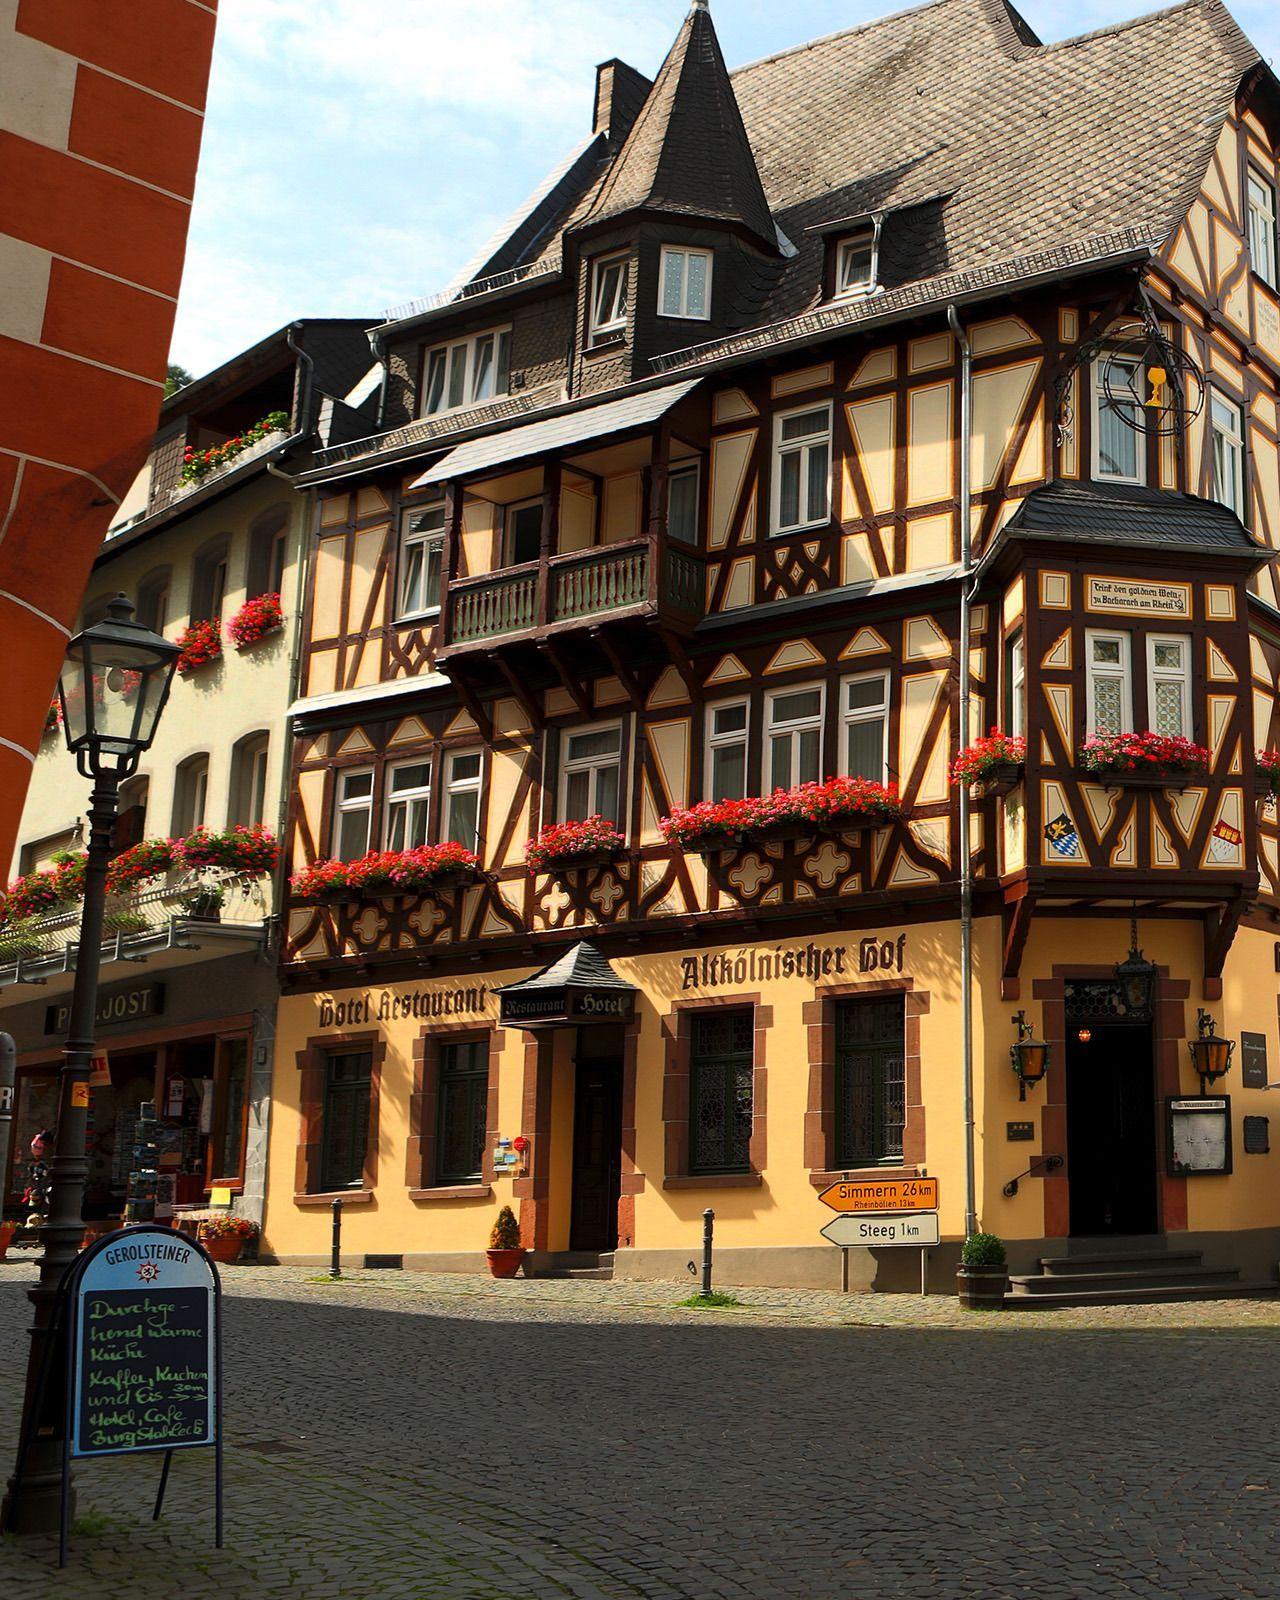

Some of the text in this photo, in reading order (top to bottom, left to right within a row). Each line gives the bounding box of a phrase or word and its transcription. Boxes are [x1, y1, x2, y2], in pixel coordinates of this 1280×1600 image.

[681, 933, 906, 991] Altkölnischer Hof
[102, 989, 152, 1020] JOST
[319, 985, 488, 1028] Hotel Restaurant
[504, 999, 566, 1016] Restaurant
[579, 993, 624, 1016] Hotel
[839, 1185, 897, 1199] Simmern
[854, 1200, 897, 1209] Rheinböllen
[859, 1223, 896, 1240] Steeg
[105, 1243, 191, 1266] GEROLSTEINER
[90, 1342, 147, 1361] Küche
[88, 1386, 164, 1407] und Eis
